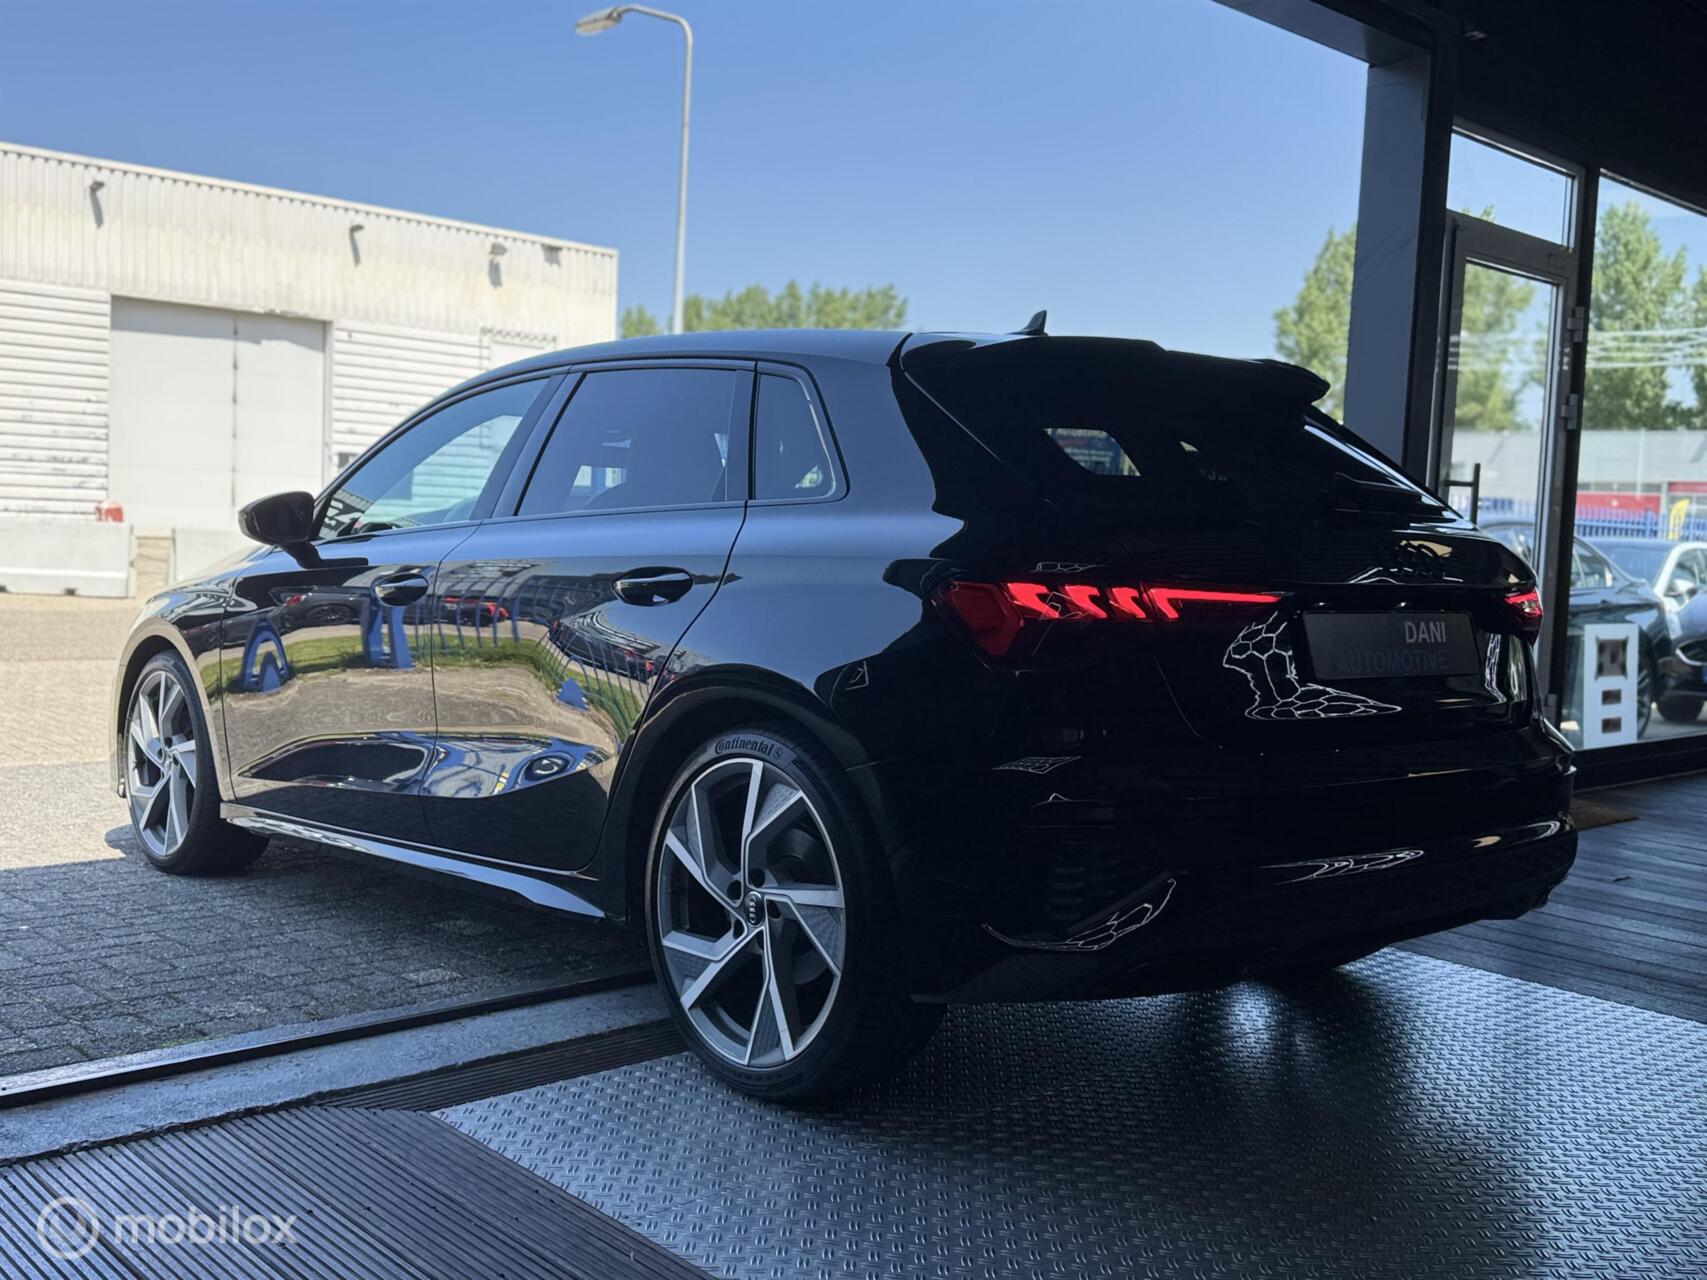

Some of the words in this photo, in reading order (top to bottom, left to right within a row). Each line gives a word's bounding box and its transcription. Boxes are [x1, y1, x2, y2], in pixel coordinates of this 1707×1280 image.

[1404, 621, 1447, 644] DANI
[1338, 649, 1449, 673] AUTOMOTIVE
[714, 737, 775, 756] Continental
